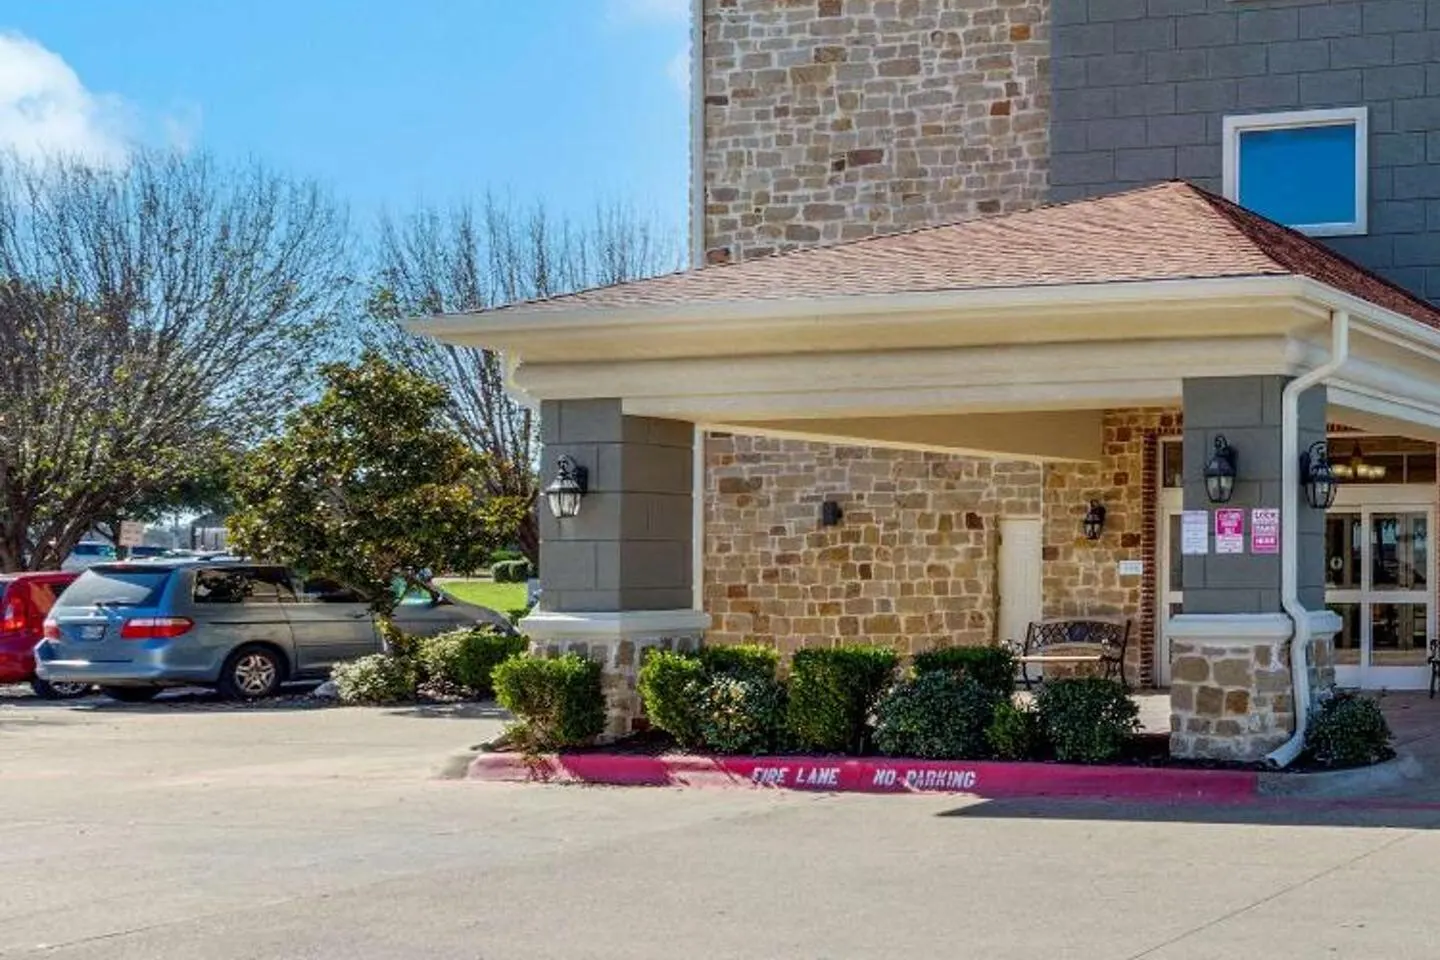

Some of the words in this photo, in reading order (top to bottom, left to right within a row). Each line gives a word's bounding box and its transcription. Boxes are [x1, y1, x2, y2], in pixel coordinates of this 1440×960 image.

[751, 767, 790, 785] FIRE
[796, 767, 840, 785] LANE
[873, 768, 897, 785] NO
[902, 769, 976, 788] PARKING
